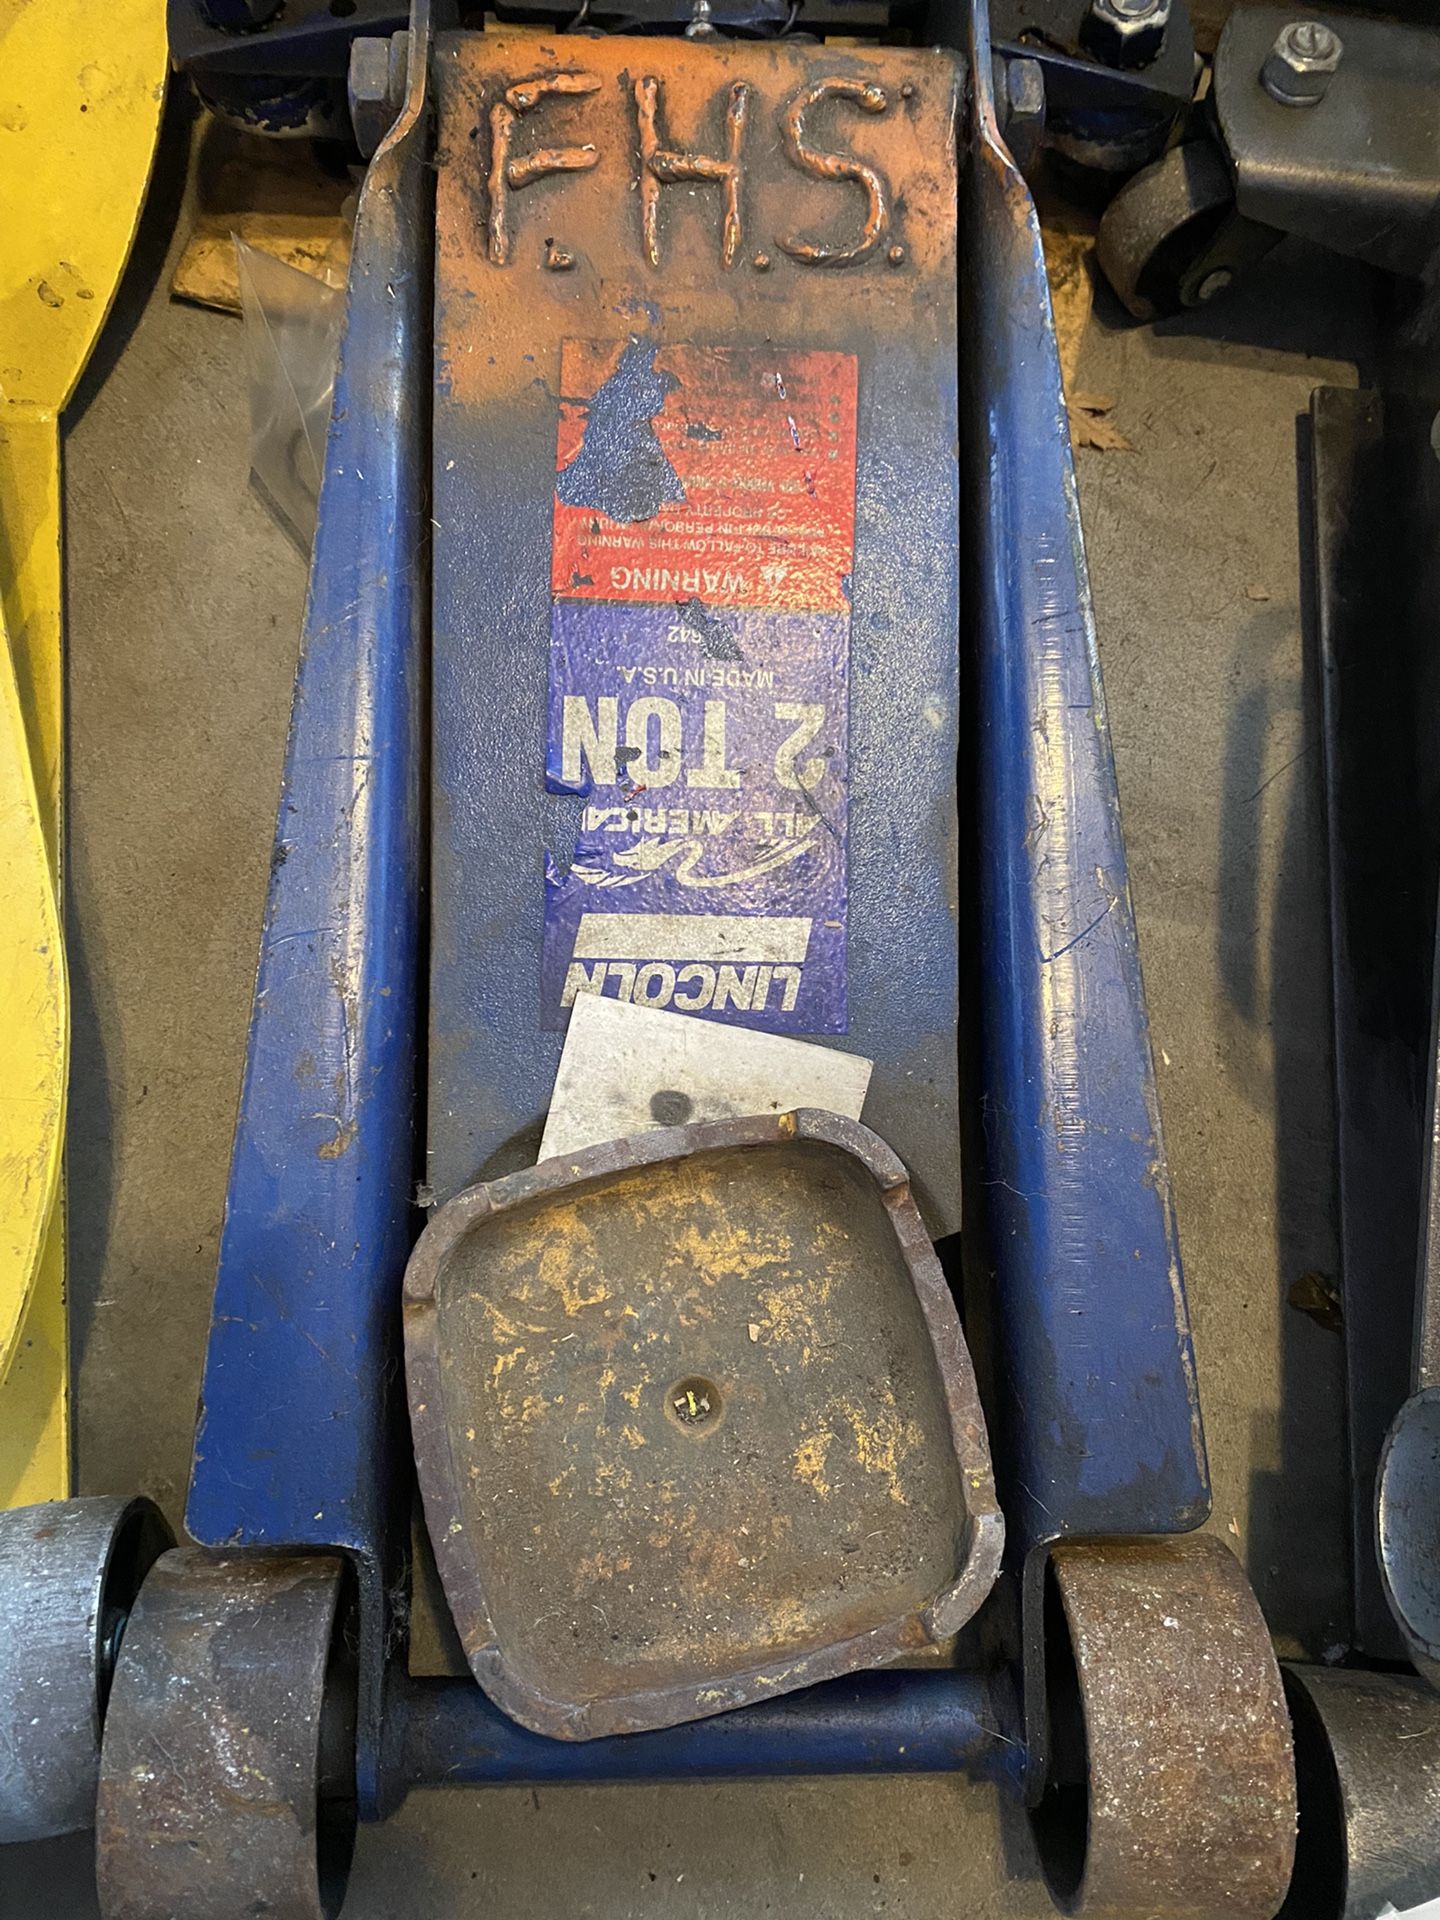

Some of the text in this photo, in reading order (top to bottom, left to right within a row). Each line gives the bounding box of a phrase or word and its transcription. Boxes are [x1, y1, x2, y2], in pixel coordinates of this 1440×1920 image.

[576, 534, 644, 550] WARNING
[648, 537, 682, 550] THIS
[610, 566, 746, 592] WARNING
[616, 665, 774, 686] MADE IN U.S.A.
[562, 695, 826, 790] 2 TON
[580, 806, 823, 838] ALL AMERICA
[560, 962, 804, 1011] LINCOLN
